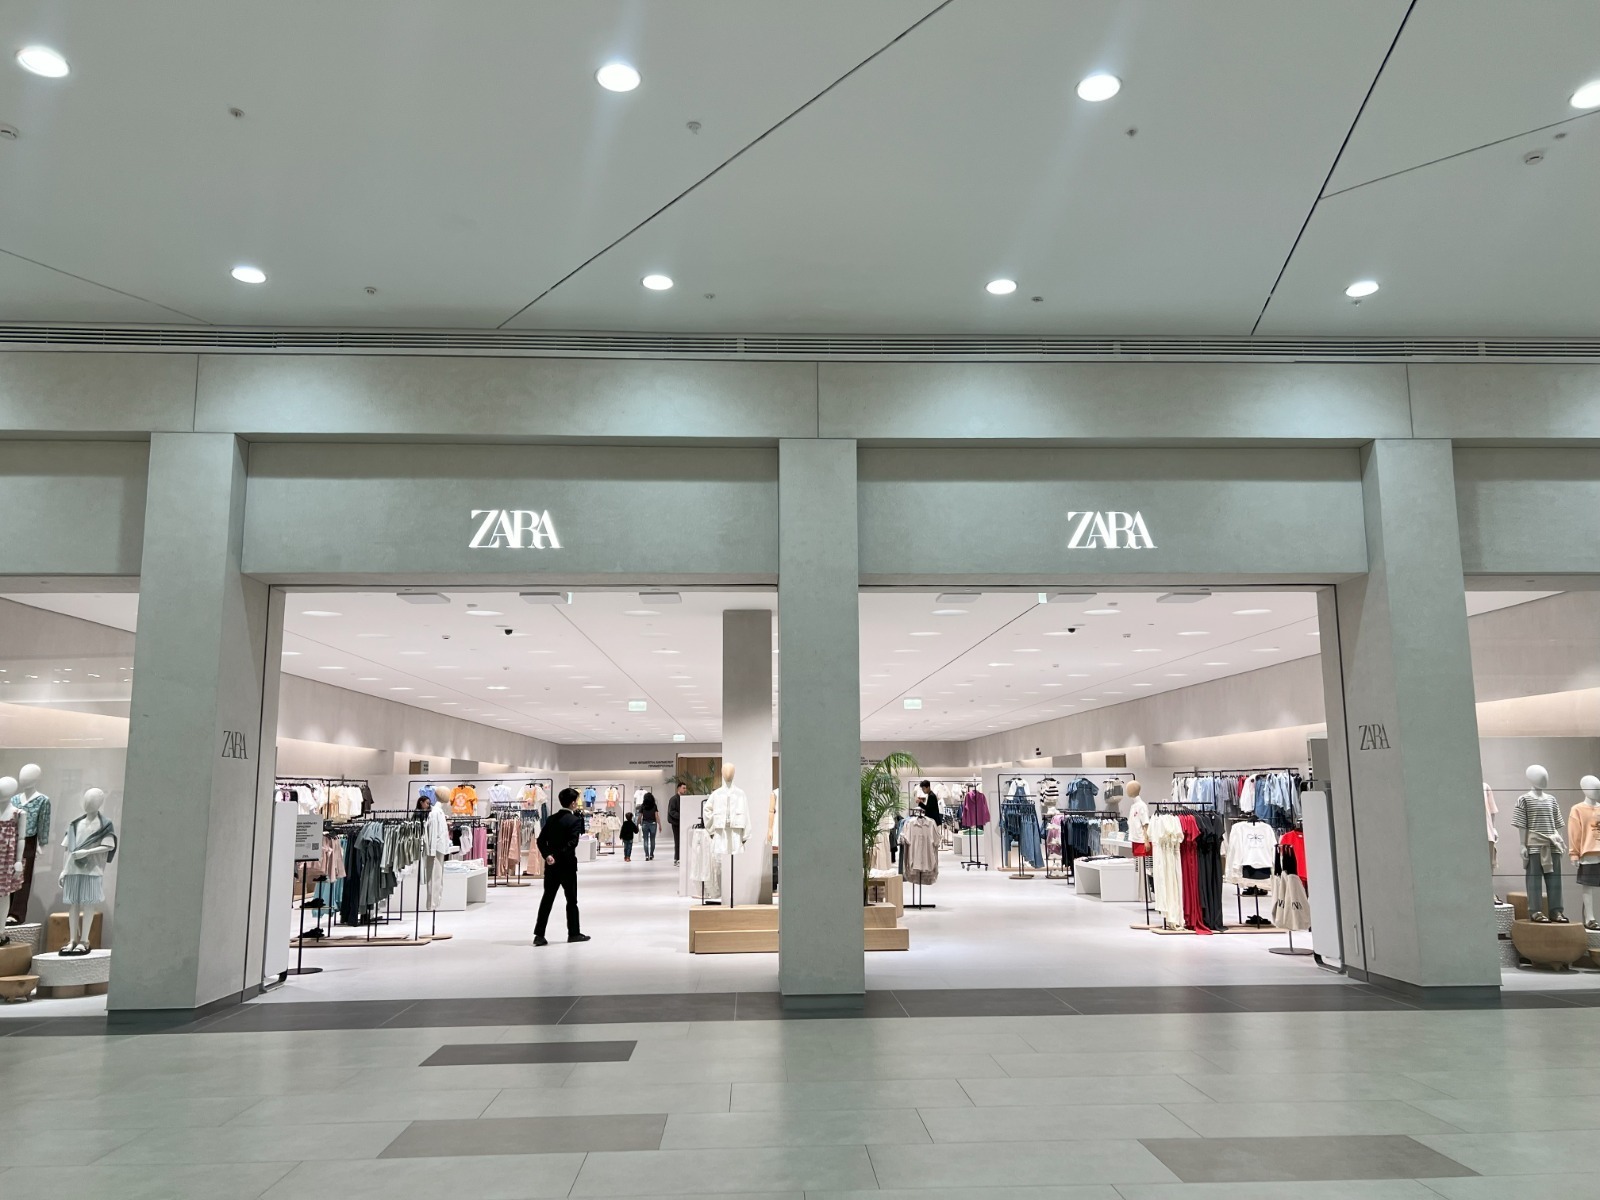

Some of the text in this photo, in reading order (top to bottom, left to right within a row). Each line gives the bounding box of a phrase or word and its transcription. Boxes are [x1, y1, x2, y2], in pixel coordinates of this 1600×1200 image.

[468, 509, 564, 550] ZARA
[1067, 511, 1158, 550] ZARA
[221, 730, 248, 759] ZARA
[1358, 723, 1391, 750] ZARA
